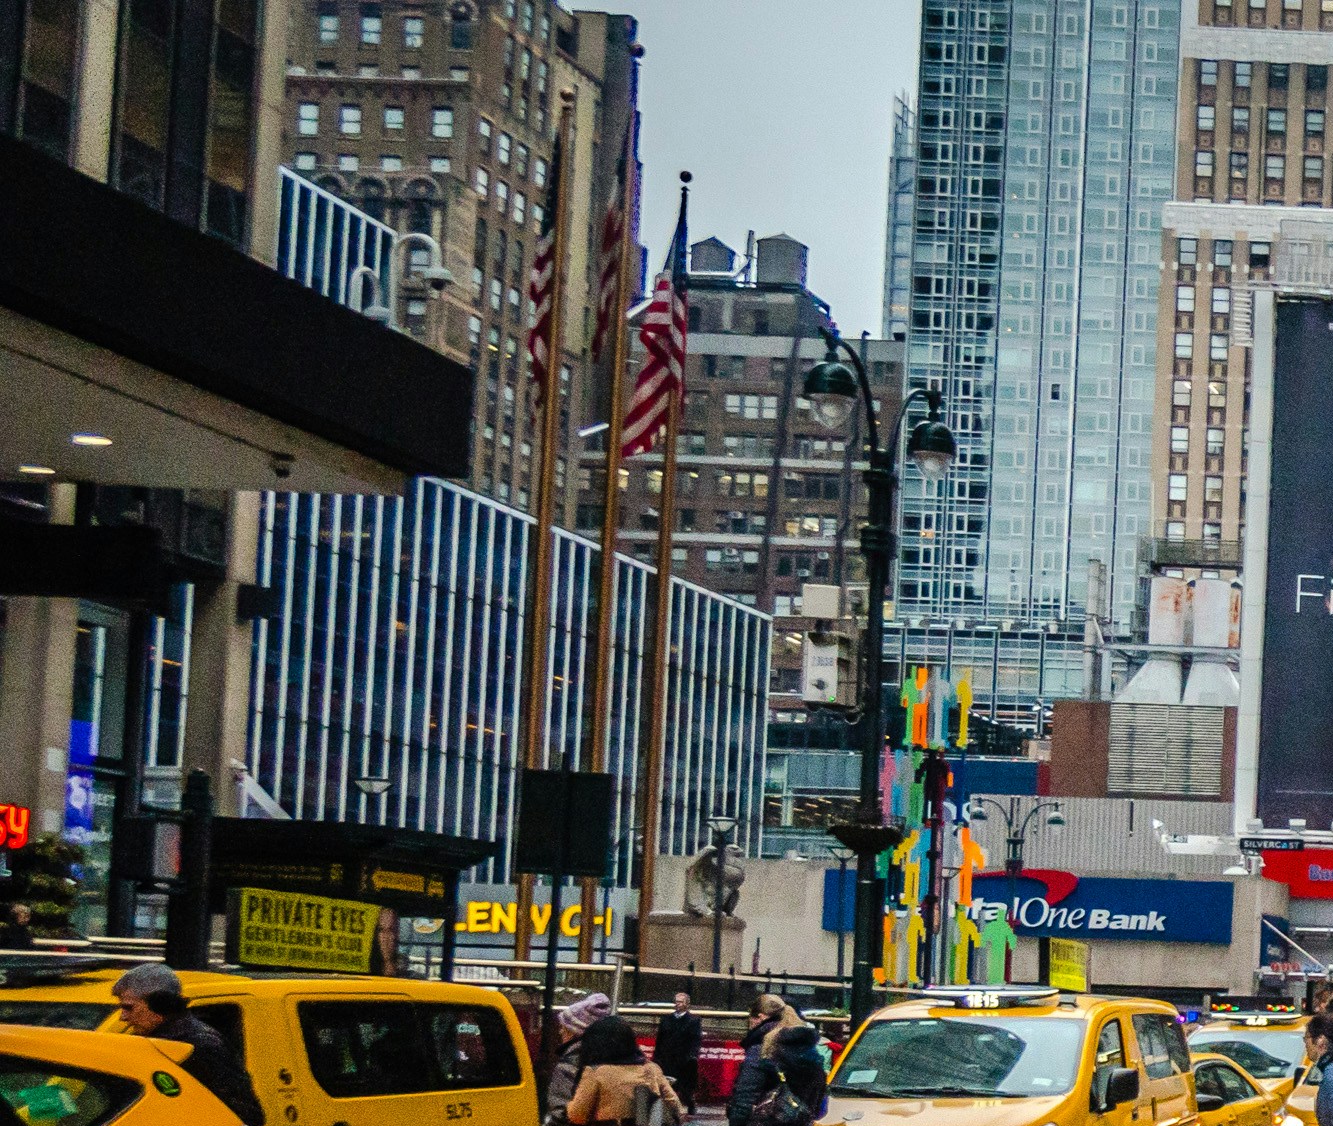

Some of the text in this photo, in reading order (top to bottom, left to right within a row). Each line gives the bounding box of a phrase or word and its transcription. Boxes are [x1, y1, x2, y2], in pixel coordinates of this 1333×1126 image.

[247, 895, 366, 935] PRIVATE EYES
[1088, 908, 1167, 932] Bank
[245, 926, 333, 949] GENTLEMEN'S
